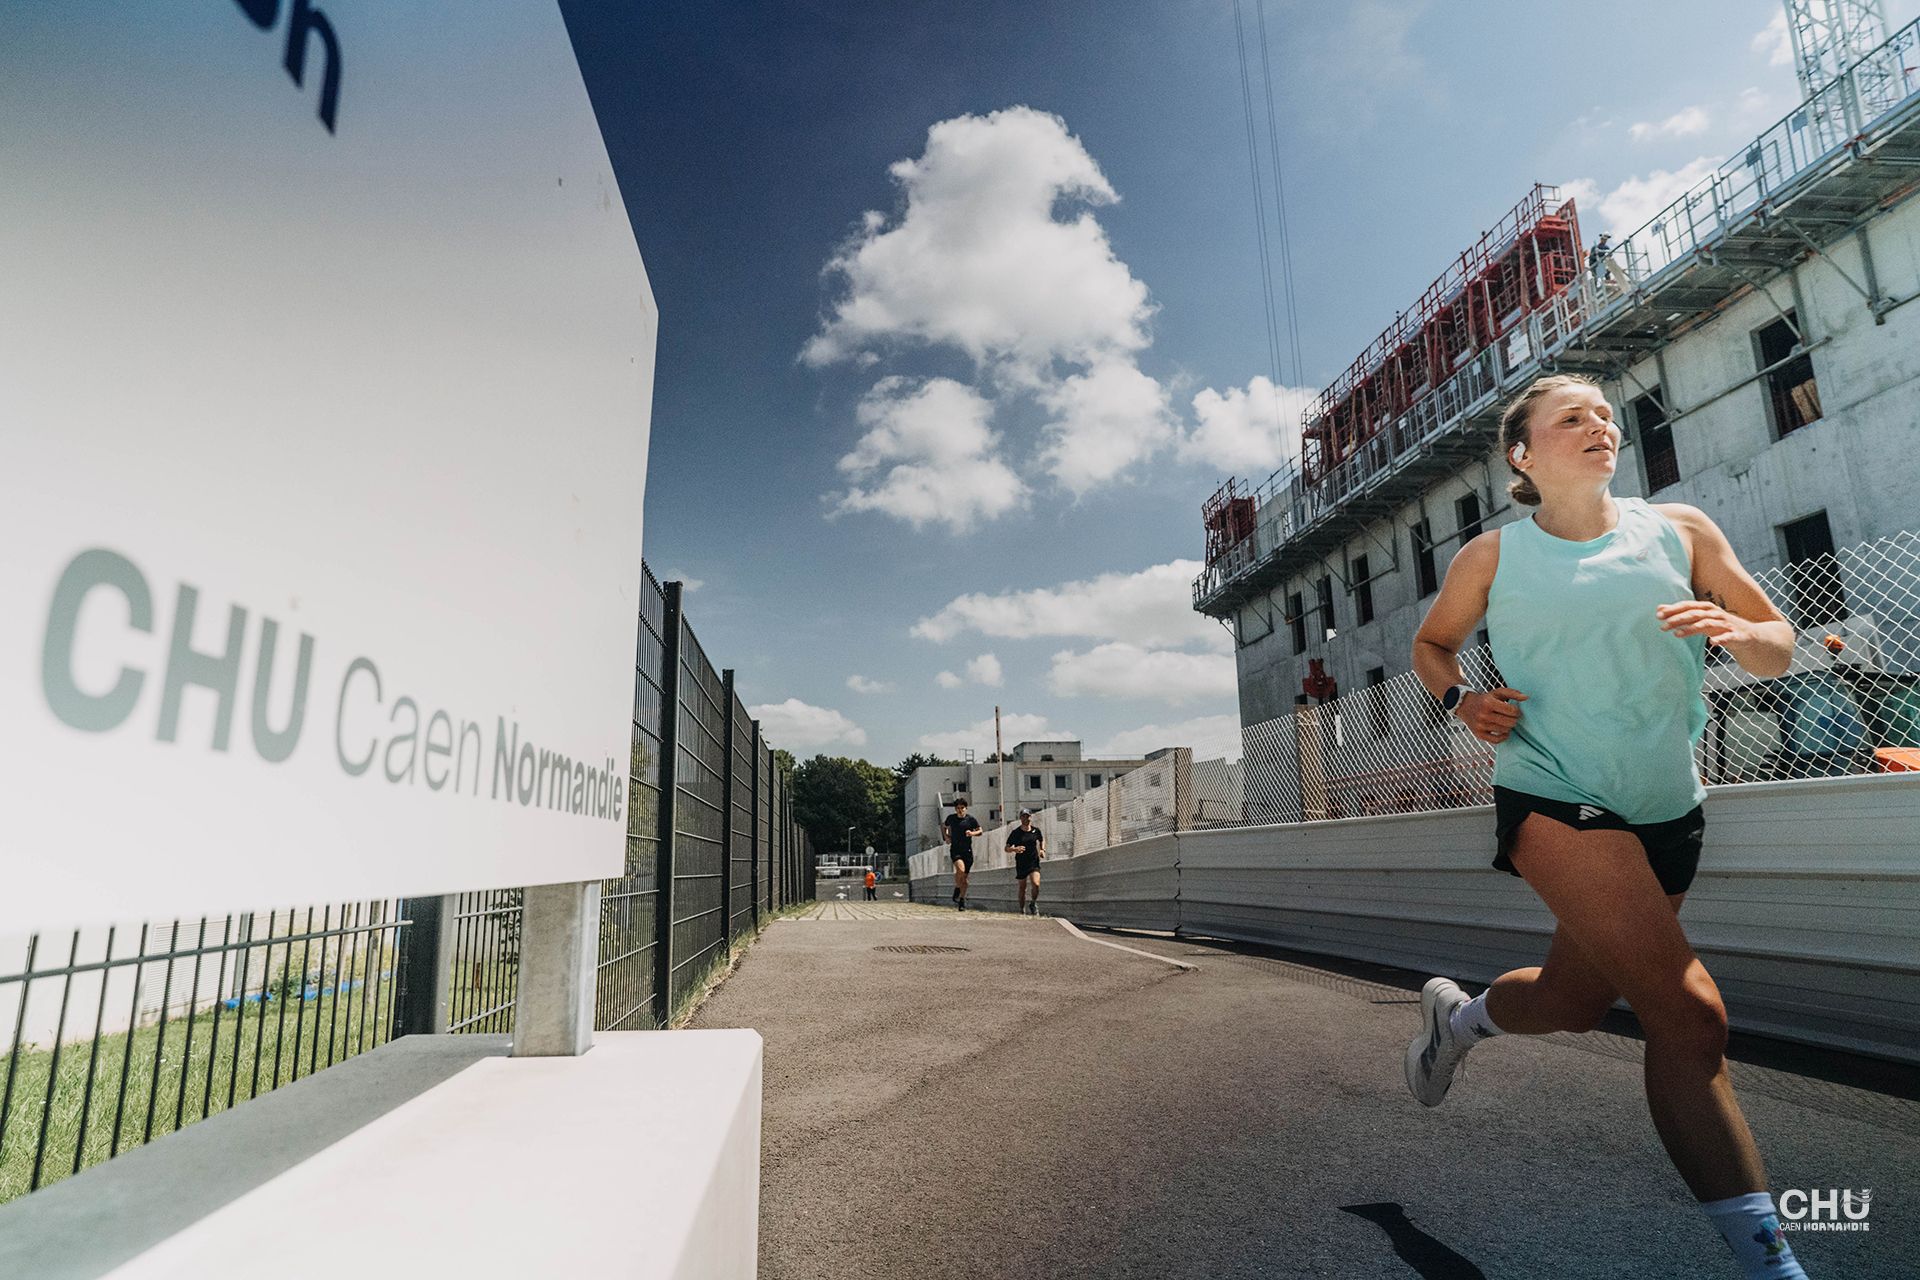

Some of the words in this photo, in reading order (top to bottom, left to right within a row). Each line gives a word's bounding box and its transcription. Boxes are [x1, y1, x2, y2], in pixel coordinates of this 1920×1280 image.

[40, 547, 314, 763] CHU
[334, 655, 483, 797] Caen
[491, 714, 623, 822] Normandie
